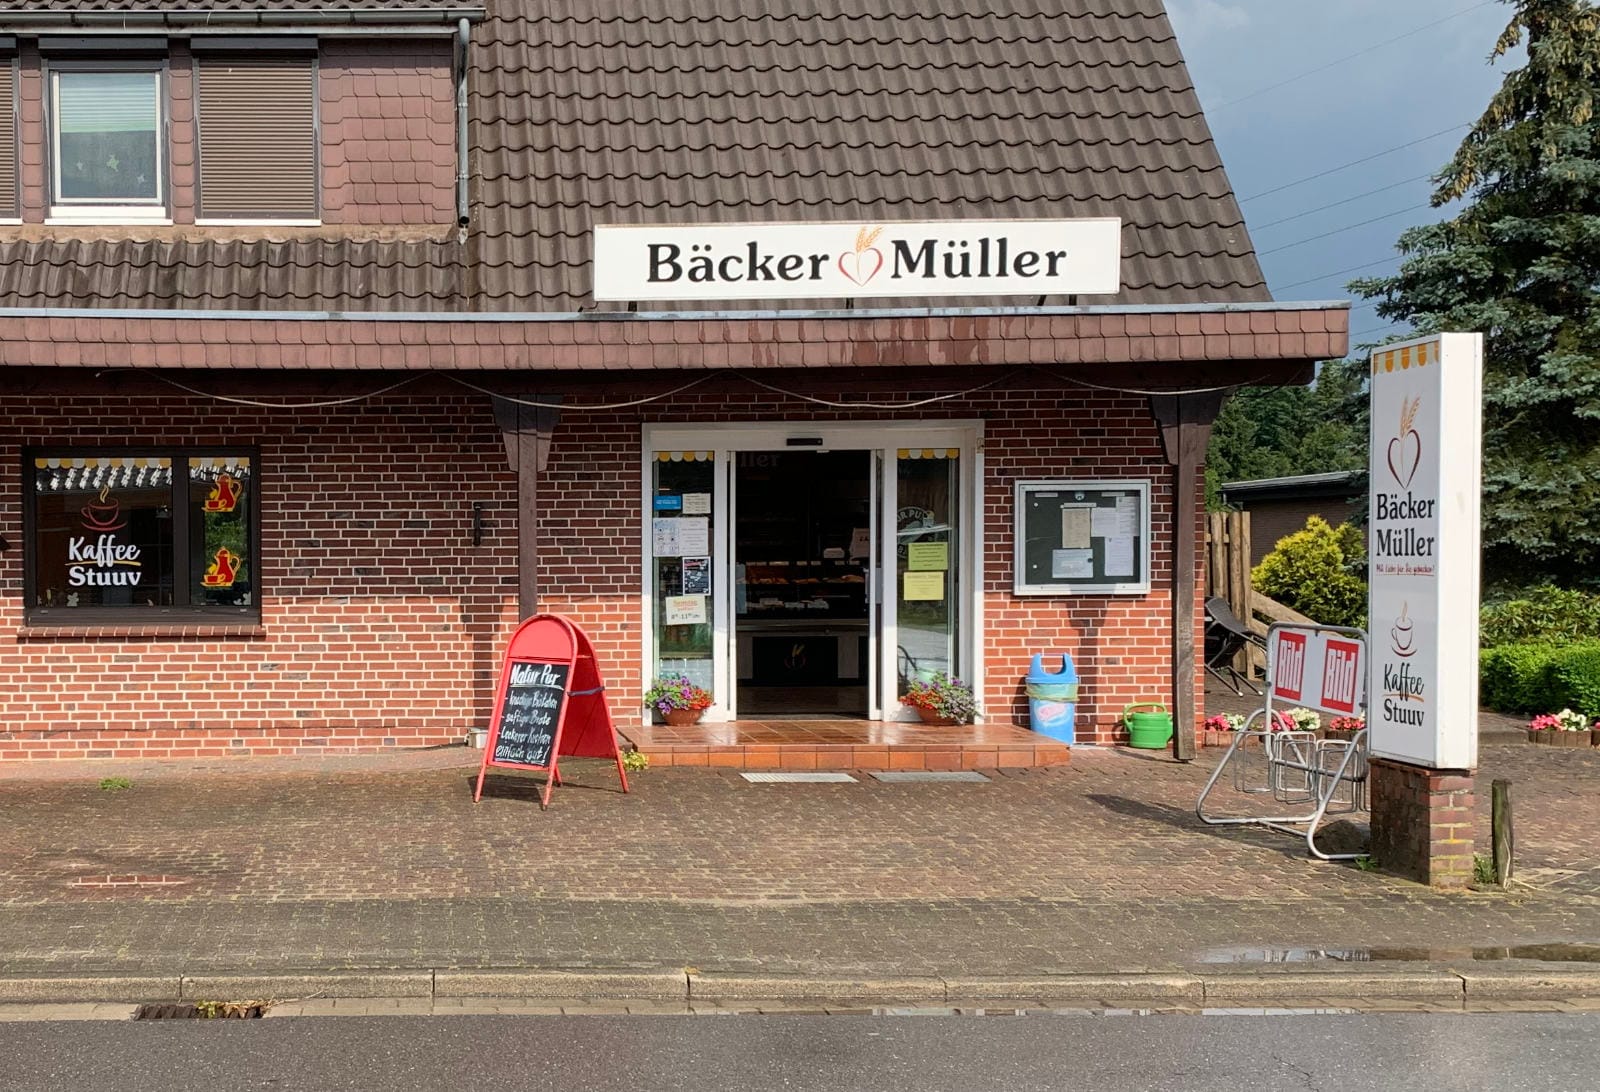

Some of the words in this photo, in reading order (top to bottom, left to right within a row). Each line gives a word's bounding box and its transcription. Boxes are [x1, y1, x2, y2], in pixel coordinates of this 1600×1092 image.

[646, 241, 830, 284] Bäcker
[890, 237, 1068, 280] Müller
[1376, 490, 1435, 521] Bäcker
[68, 534, 141, 568] Kaffee
[1376, 527, 1435, 558] Müller
[68, 566, 142, 587] Stuuv
[510, 664, 541, 685] Natur
[540, 664, 561, 685] Pur
[1277, 639, 1304, 693] Bild
[1323, 647, 1357, 704] Bild
[1383, 662, 1425, 702] Kaffee
[1383, 698, 1425, 727] Stuuv
